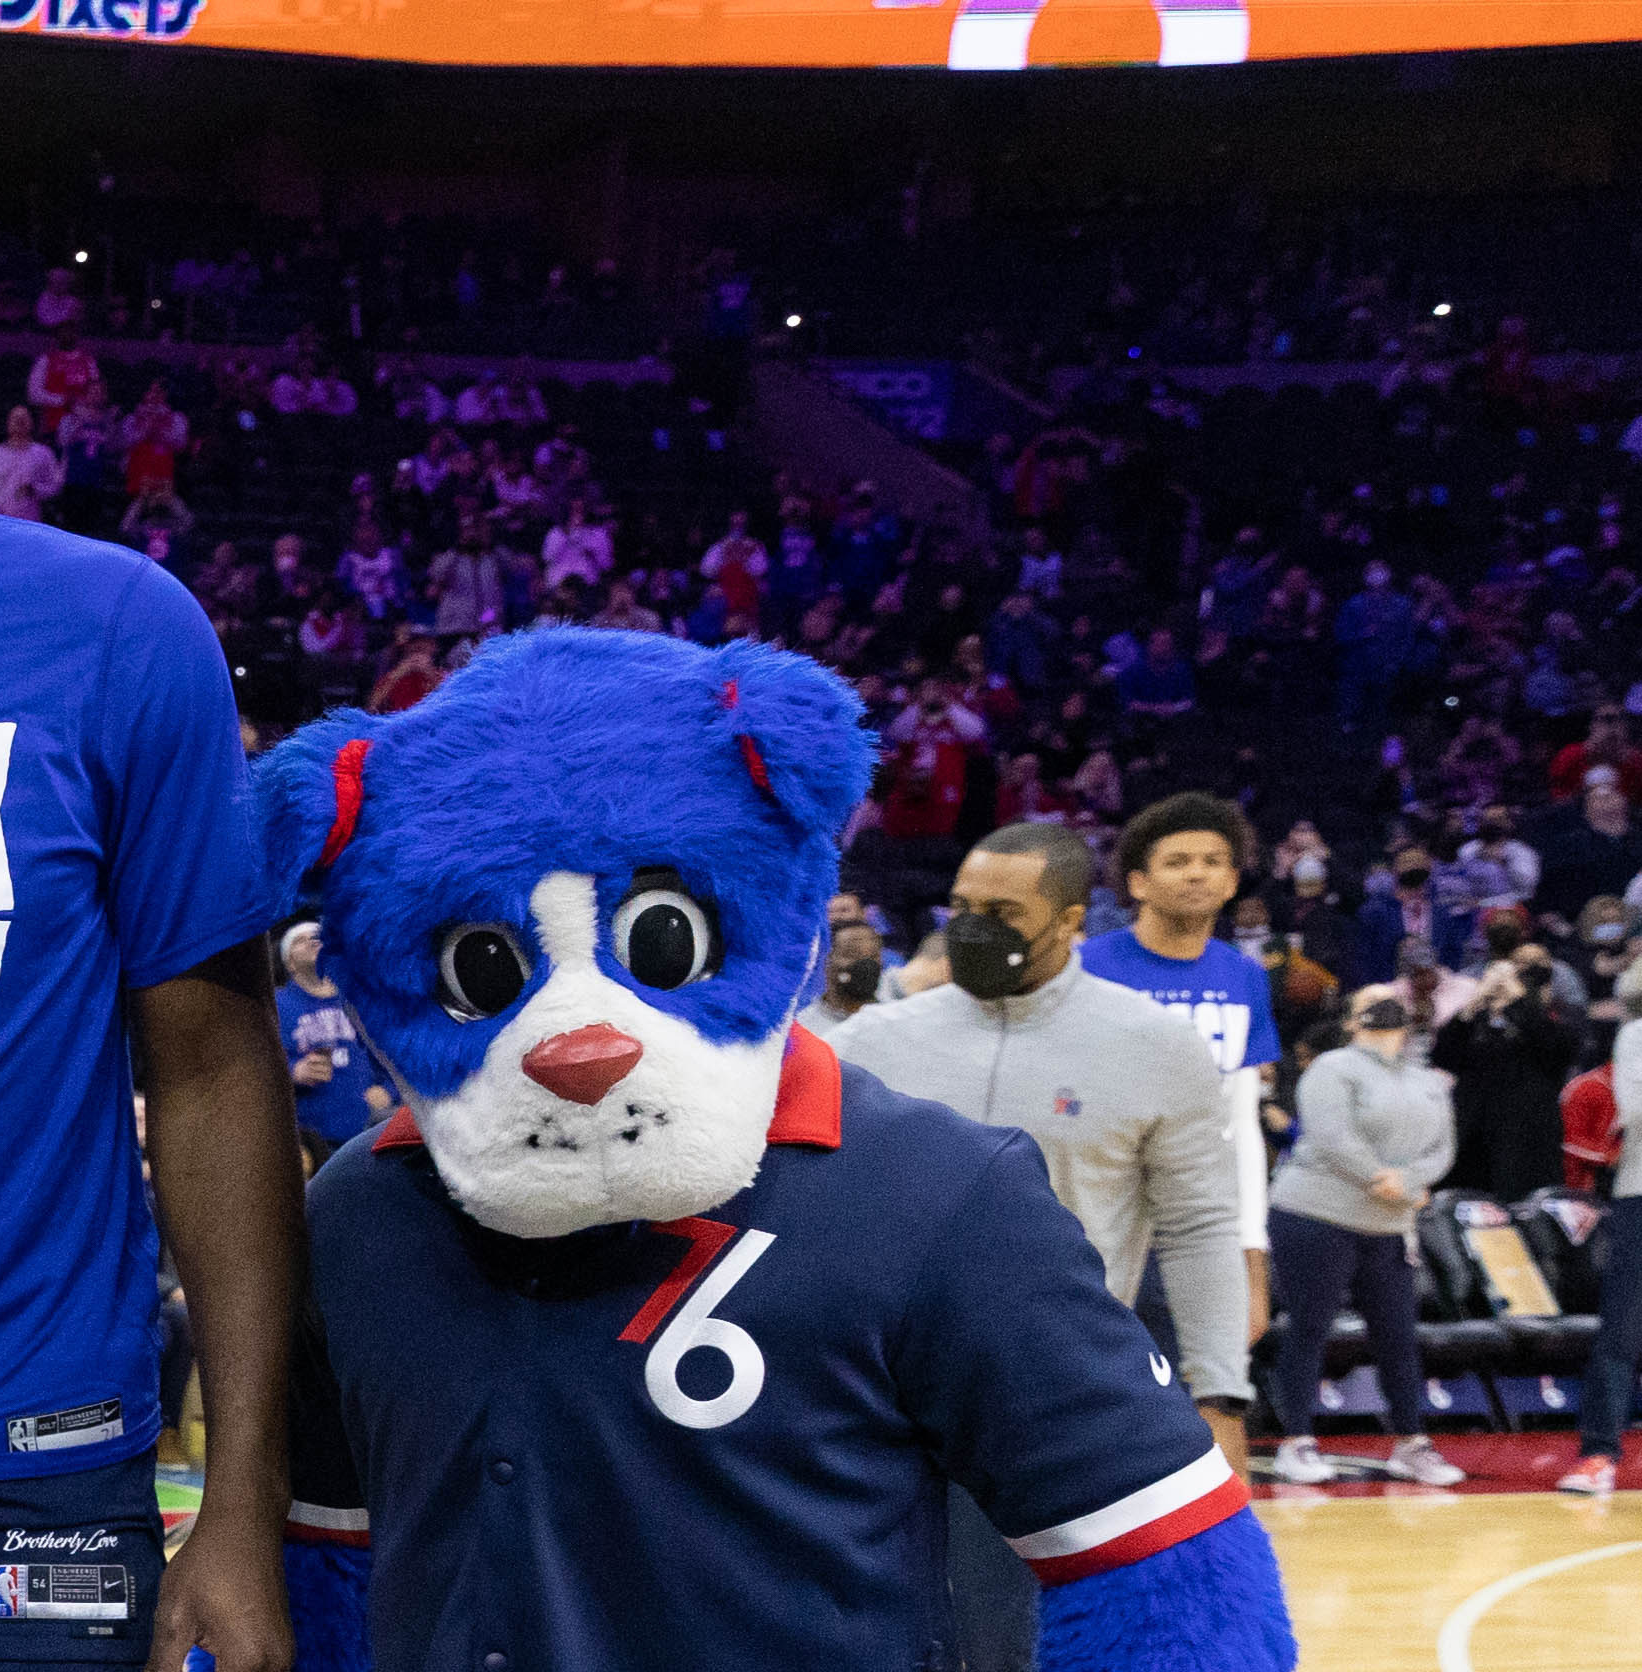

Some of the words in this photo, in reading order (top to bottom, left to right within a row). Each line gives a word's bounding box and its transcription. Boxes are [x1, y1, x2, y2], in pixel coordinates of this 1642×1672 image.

[617, 1216, 778, 1429] 76
[3, 1528, 85, 1555] Brotherly
[82, 1529, 119, 1552] Love
[32, 1578, 46, 1589] 54
